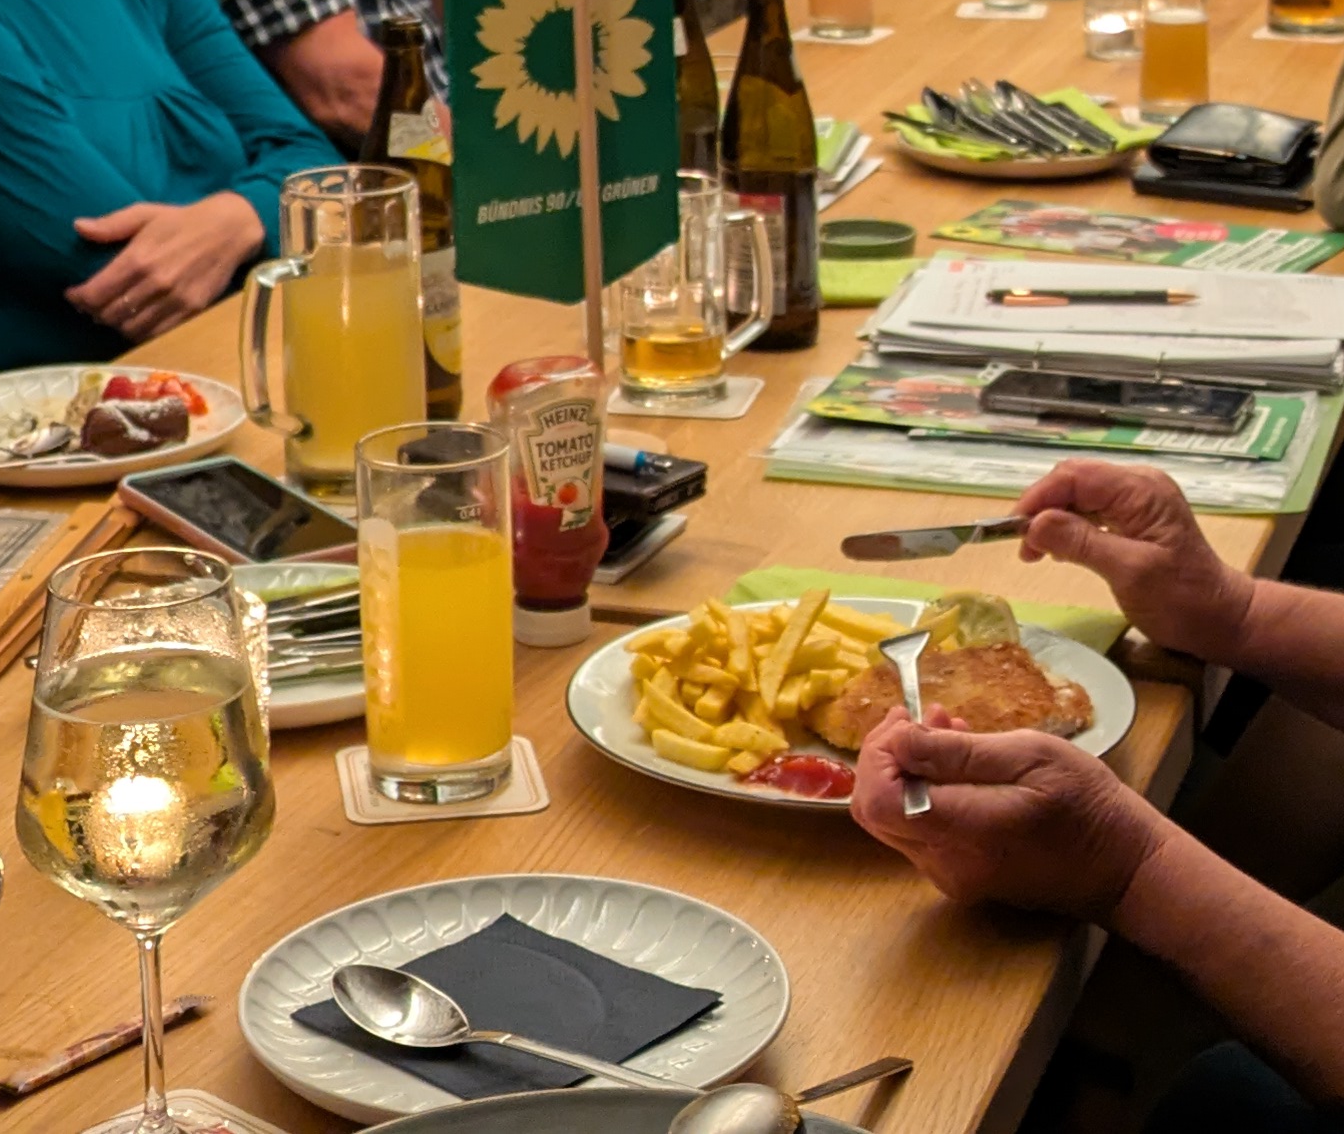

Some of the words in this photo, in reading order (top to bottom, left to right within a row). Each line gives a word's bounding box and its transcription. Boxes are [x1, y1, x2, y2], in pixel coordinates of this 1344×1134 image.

[477, 196, 544, 225] BÜNDNIS
[602, 174, 659, 203] GRÜNEN
[543, 407, 589, 429] HEINZ
[536, 432, 594, 459] TOMATO
[539, 450, 592, 472] KETCHUP
